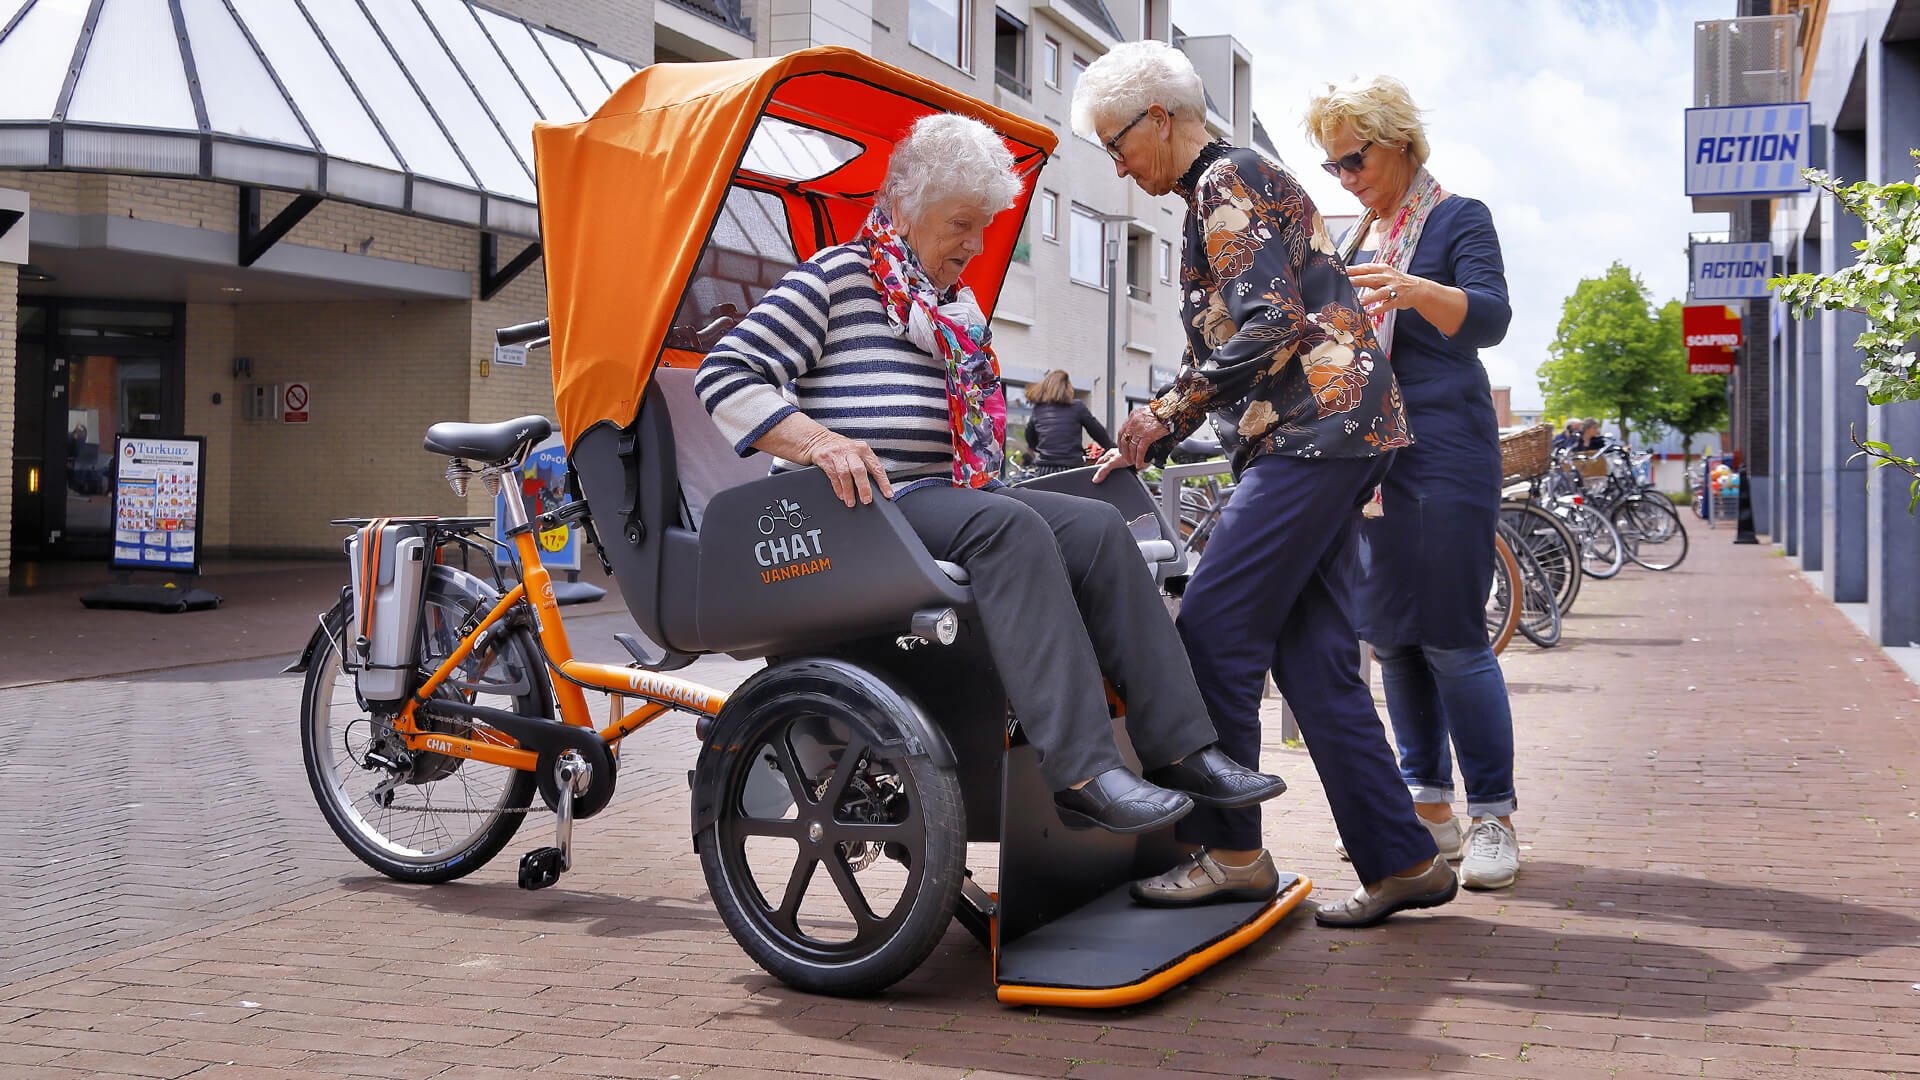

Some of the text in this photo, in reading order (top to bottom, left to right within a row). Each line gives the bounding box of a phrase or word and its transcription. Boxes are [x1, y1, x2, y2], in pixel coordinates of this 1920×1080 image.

[1696, 133, 1800, 165] ACTION
[1700, 260, 1766, 279] ACTION
[1686, 333, 1739, 346] SCAPINO
[137, 442, 189, 456] Turkuaz
[754, 528, 822, 567] CHAT
[760, 557, 832, 584] VANRAAM
[629, 675, 710, 708] VANRAAM
[425, 738, 453, 753] CHAT
